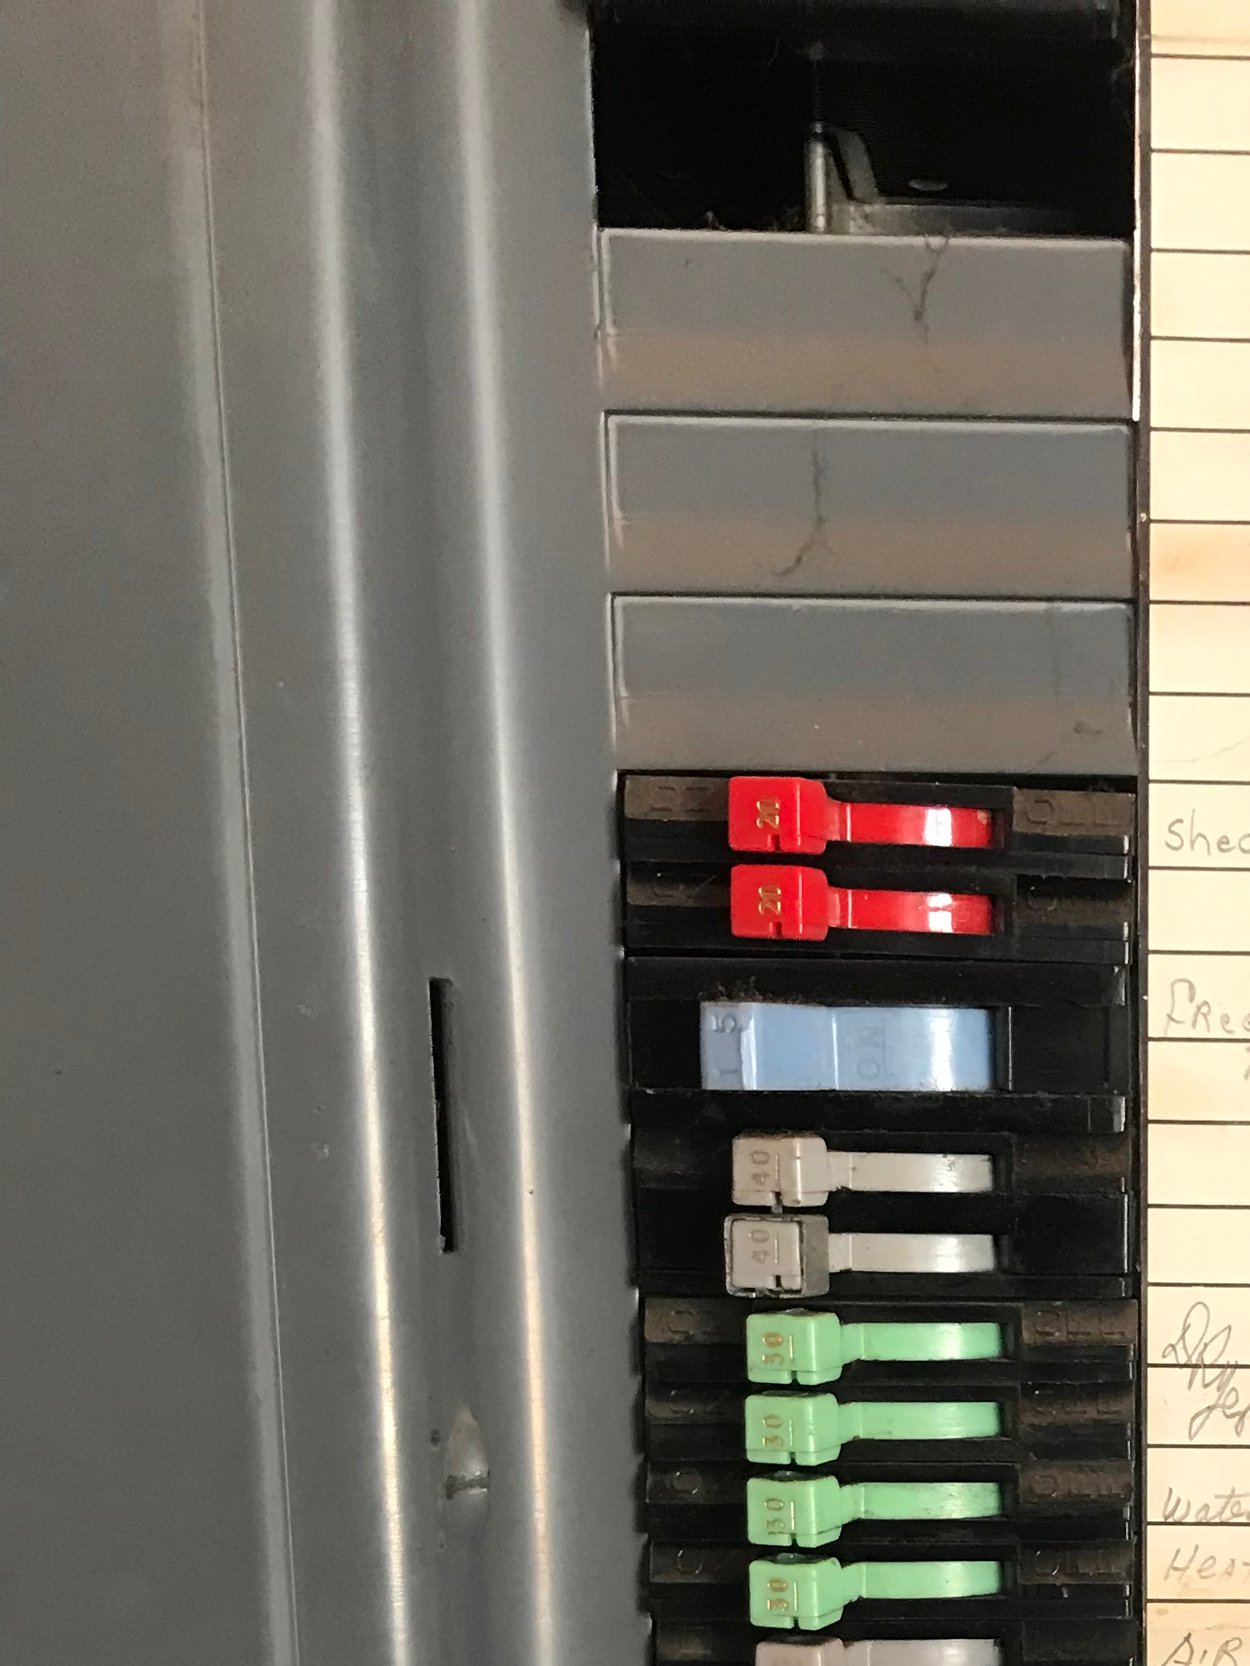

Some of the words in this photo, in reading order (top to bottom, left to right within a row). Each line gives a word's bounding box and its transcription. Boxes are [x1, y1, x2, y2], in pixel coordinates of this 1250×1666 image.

[761, 1330, 785, 1367] 30
[762, 1413, 785, 1449] 30
[766, 1497, 786, 1536] 30
[766, 1576, 790, 1613] 30
